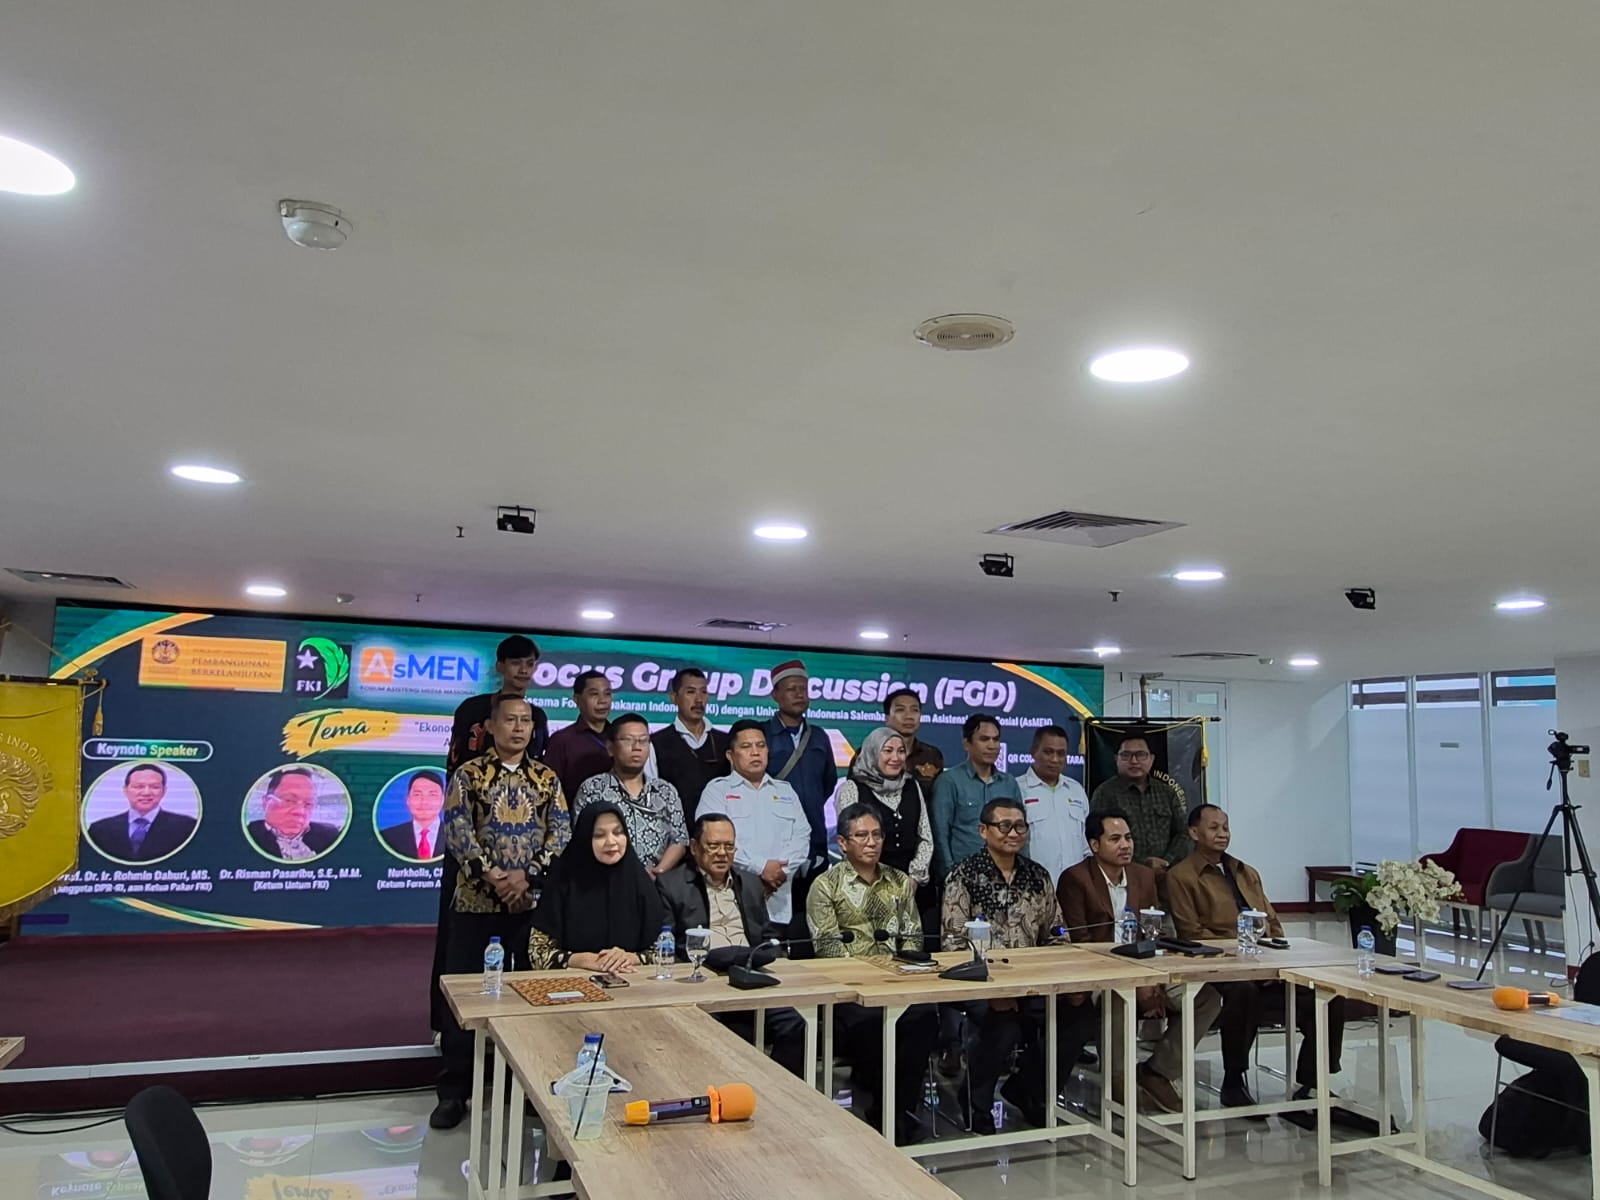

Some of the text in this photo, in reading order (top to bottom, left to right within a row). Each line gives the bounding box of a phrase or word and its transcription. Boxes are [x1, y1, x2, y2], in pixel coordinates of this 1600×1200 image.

[363, 651, 480, 682] AsMEN
[296, 680, 322, 692] FKI
[532, 662, 1016, 713] ocs Grup Dcussin (FGD)
[721, 704, 755, 718] dengan
[807, 708, 849, 720] Indonesia
[297, 710, 370, 748] Tema
[414, 721, 454, 733] "Ekono
[96, 742, 199, 758] Keynote Speaker
[1007, 753, 1018, 764] QR
[84, 870, 99, 882] Dr.
[100, 870, 112, 881] Ir.
[113, 870, 152, 882] Rohmin
[191, 869, 211, 881] MS.
[219, 868, 234, 880] Dr.
[235, 868, 271, 880] Risman
[339, 867, 362, 879] M.M.
